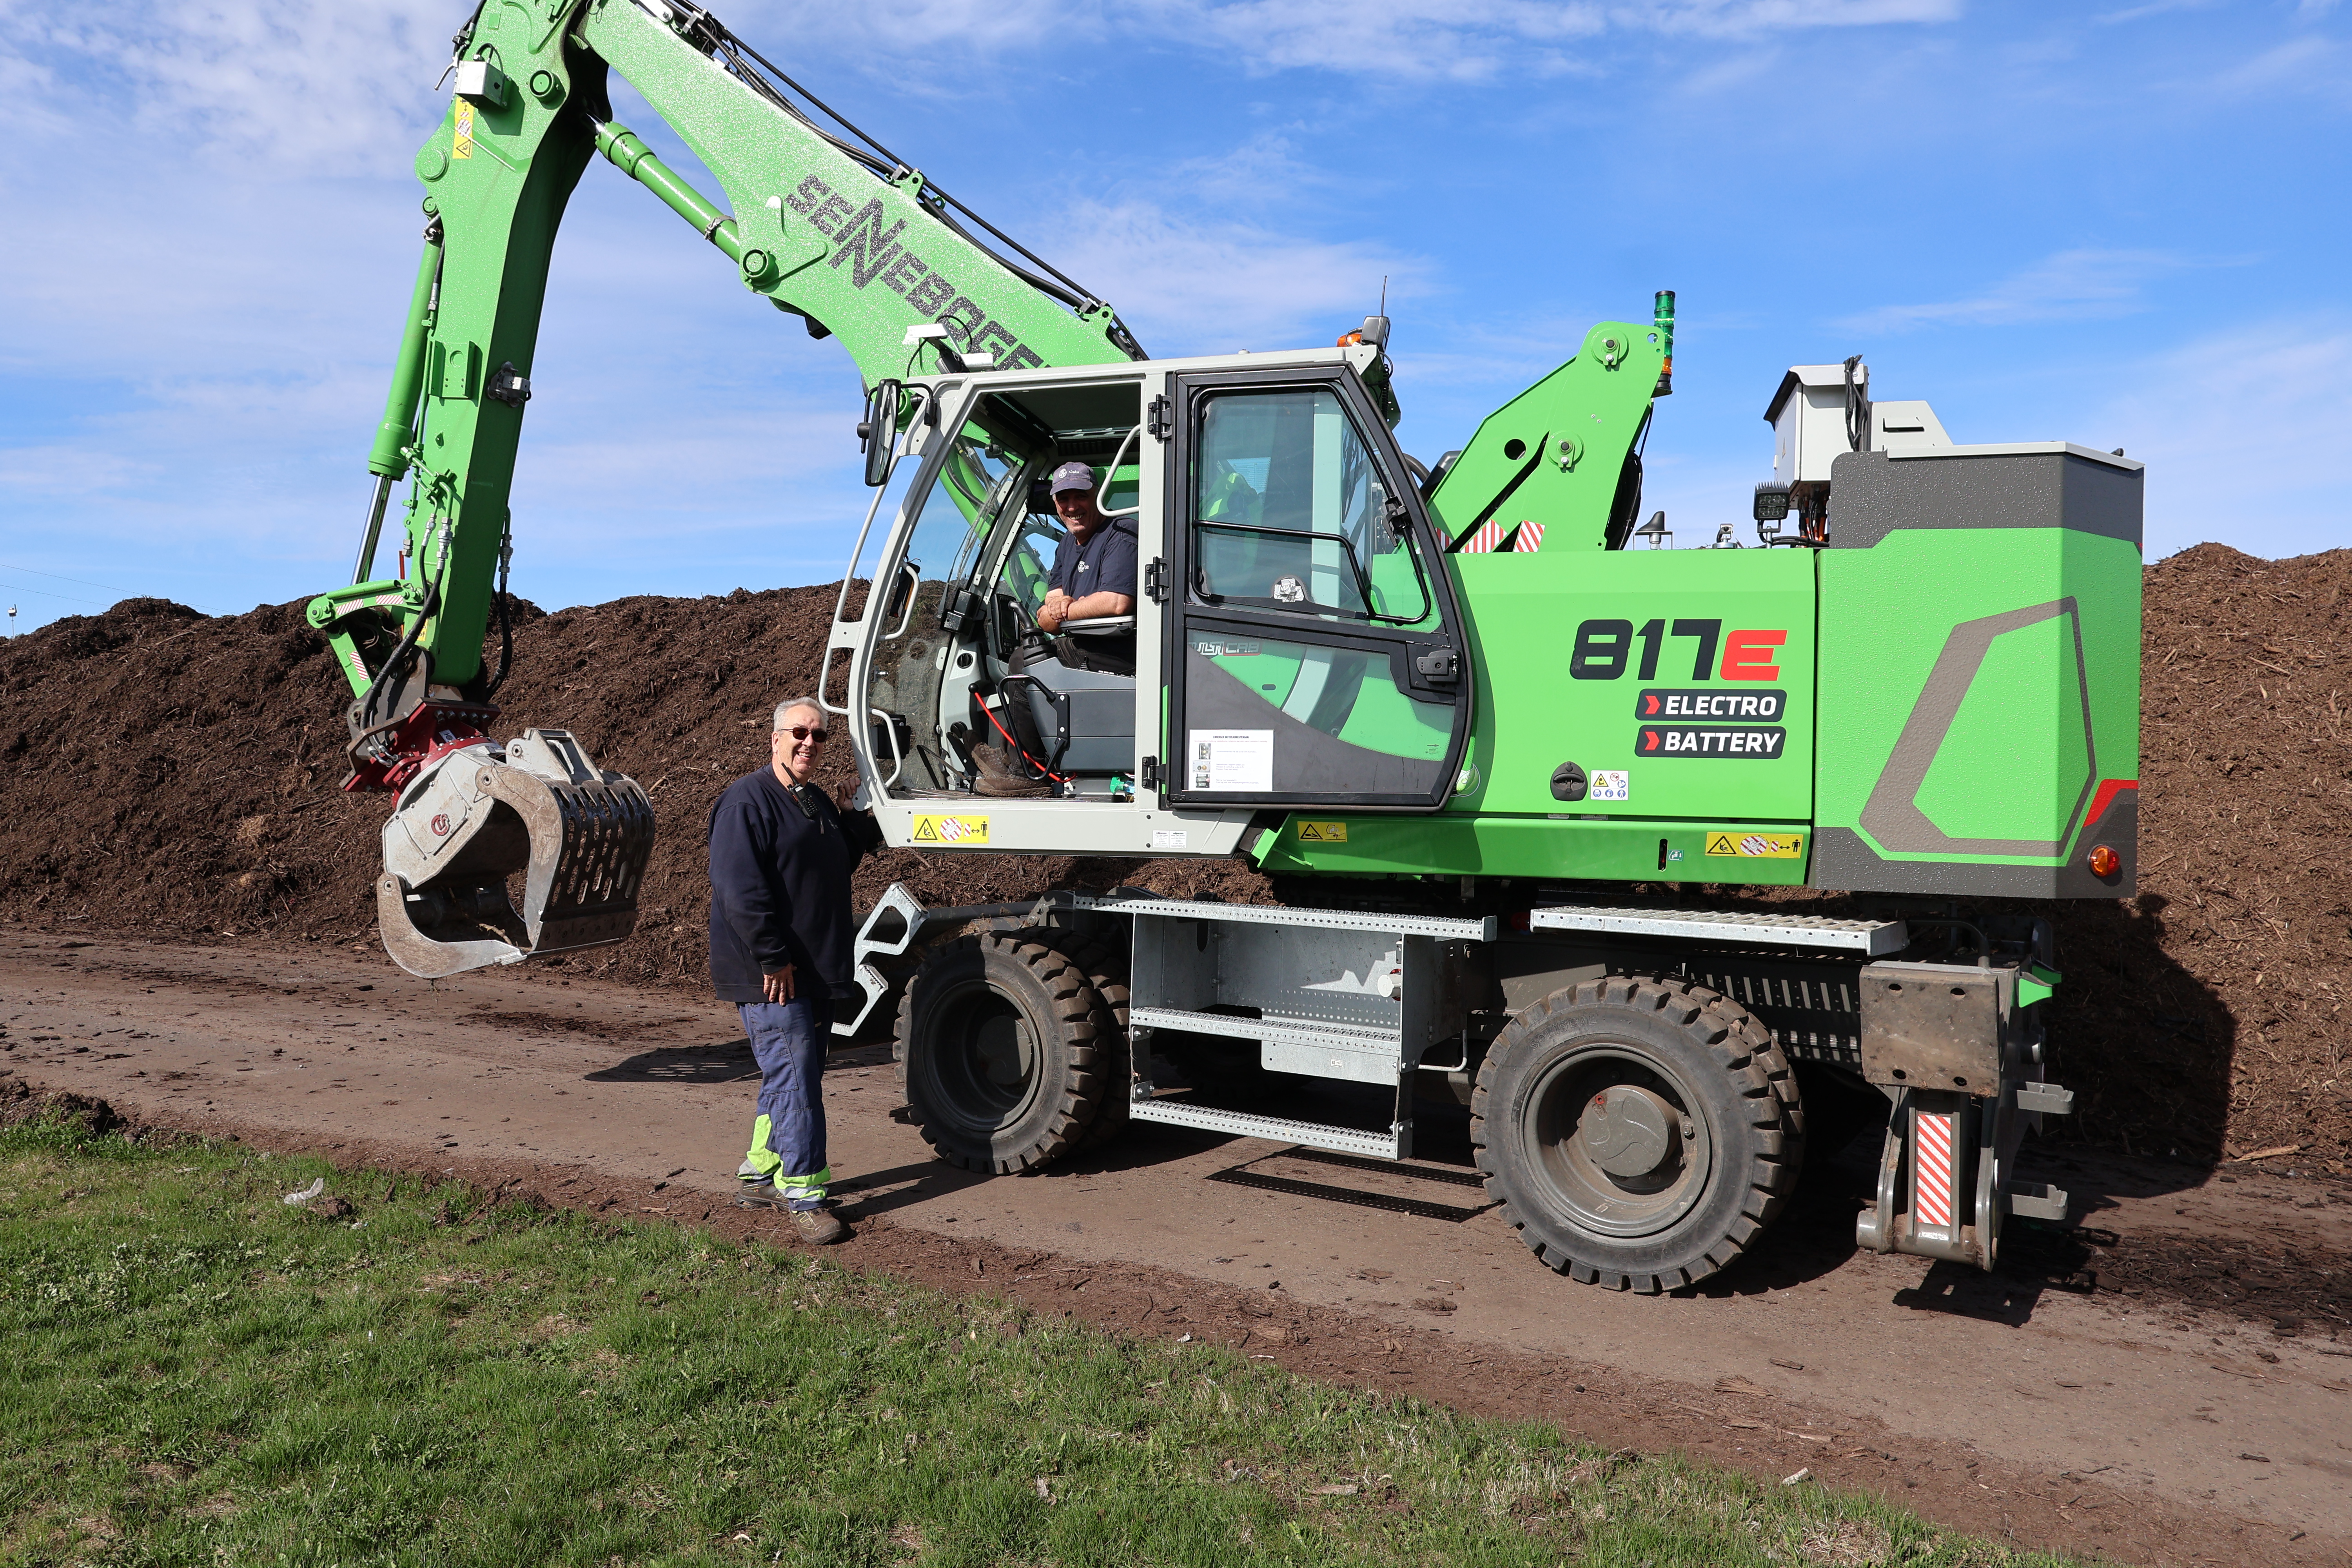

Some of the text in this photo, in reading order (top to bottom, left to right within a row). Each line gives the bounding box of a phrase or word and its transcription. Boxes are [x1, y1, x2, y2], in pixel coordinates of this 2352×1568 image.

[1569, 619, 1788, 681] 817E
[1665, 695, 1777, 716] ELECTRO
[1664, 731, 1780, 753] BATTERY
[1530, 1016, 1598, 1051] SOLIDEAL
